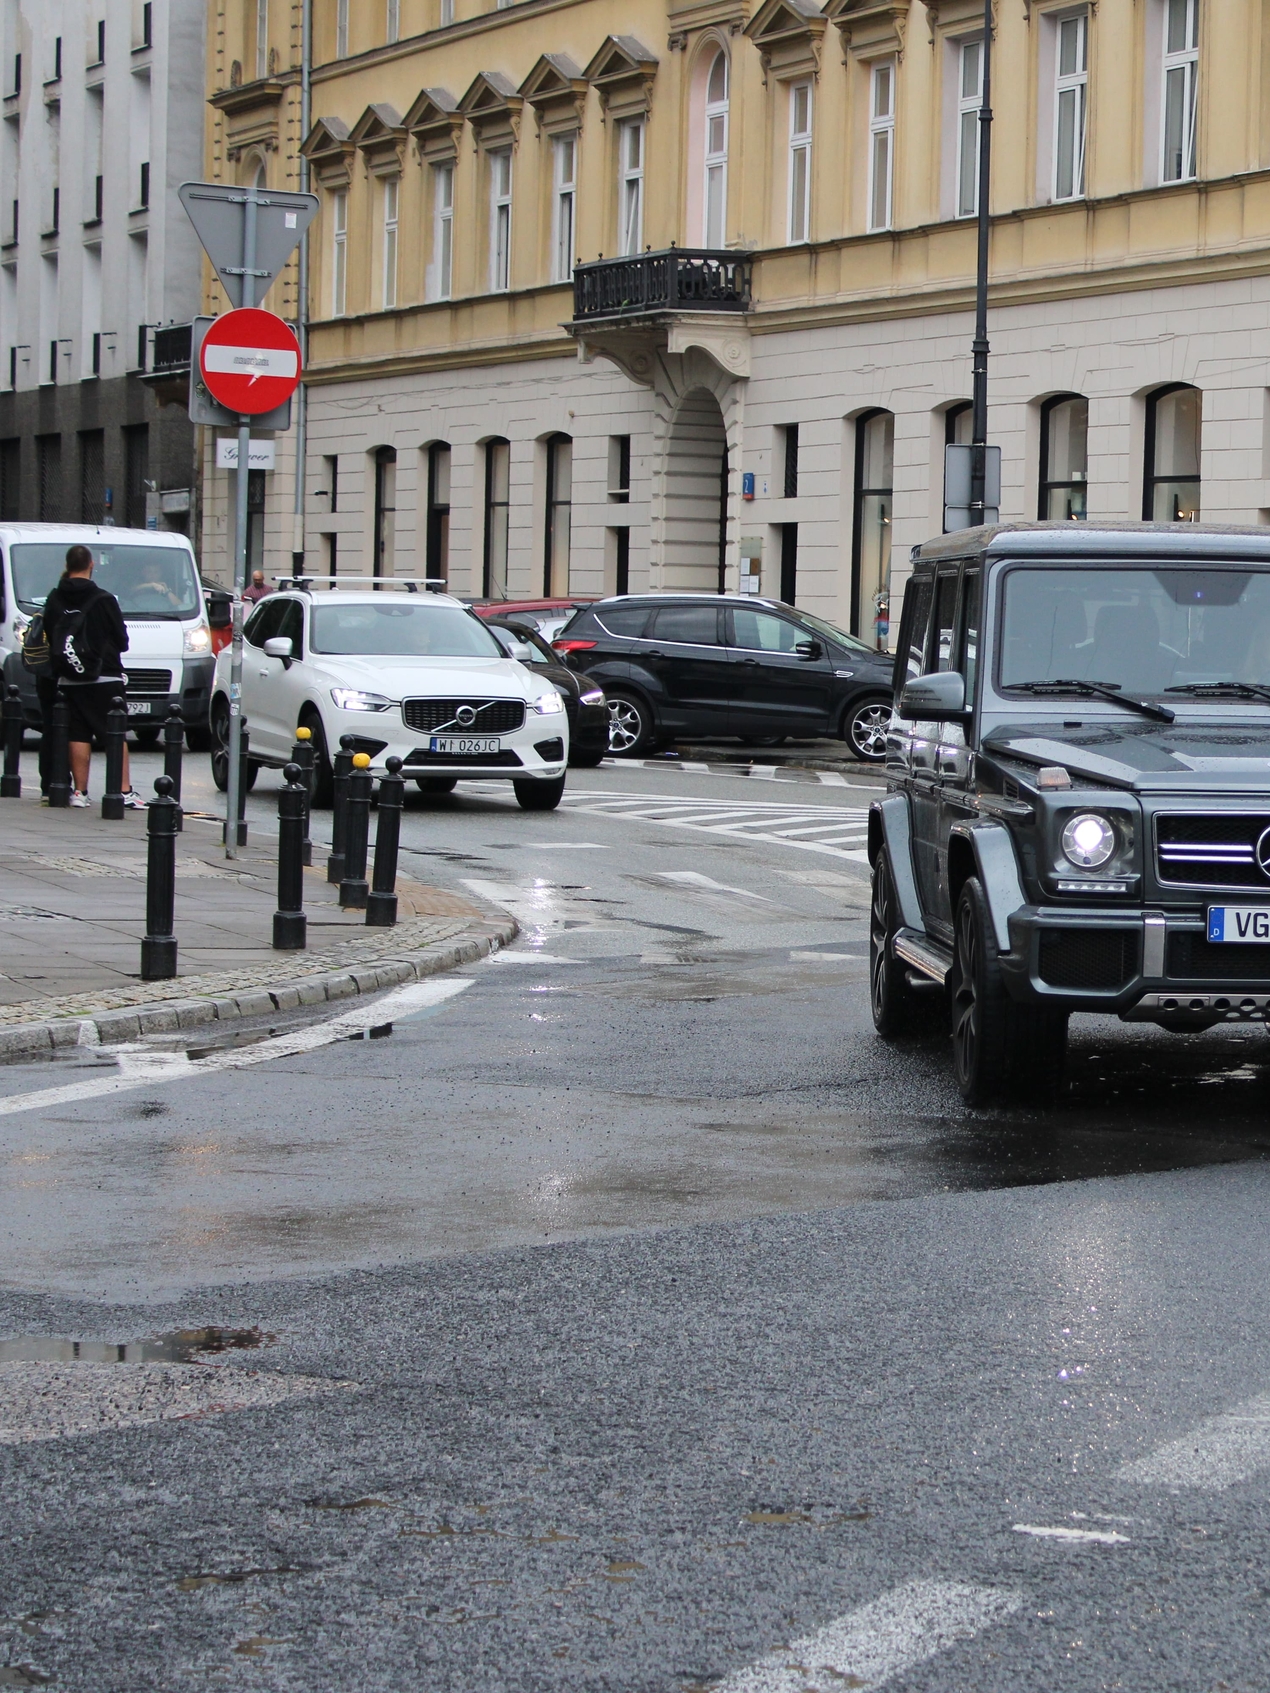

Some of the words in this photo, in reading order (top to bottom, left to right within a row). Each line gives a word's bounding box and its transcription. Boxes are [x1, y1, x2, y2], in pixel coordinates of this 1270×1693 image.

[63, 634, 85, 673] adidas
[459, 740, 496, 752] 026JC
[1213, 928, 1220, 936] D
[1235, 912, 1269, 938] VG
